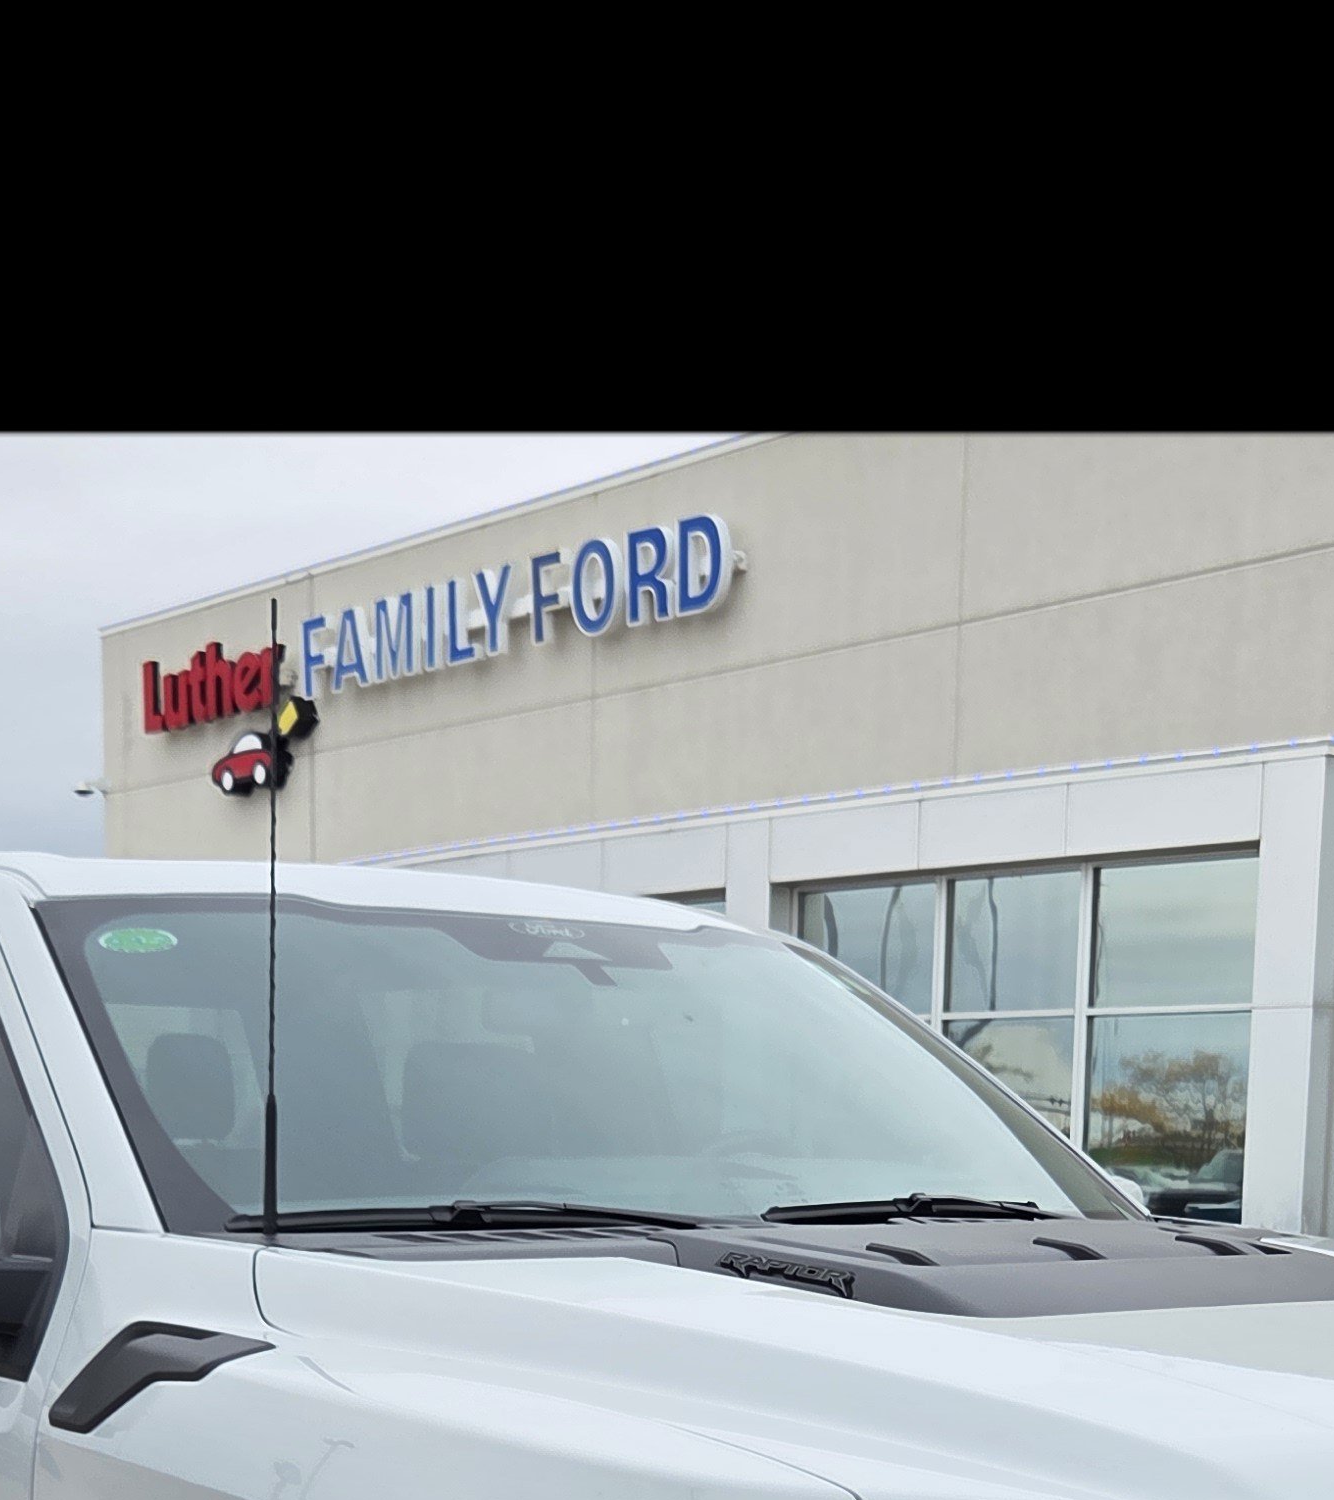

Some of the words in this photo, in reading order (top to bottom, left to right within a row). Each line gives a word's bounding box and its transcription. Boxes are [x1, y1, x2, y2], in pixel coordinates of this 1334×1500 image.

[143, 641, 286, 734] Luther
[301, 562, 512, 699] FAMILY
[530, 512, 729, 645] FORD
[719, 1251, 856, 1299] RAPTOR
